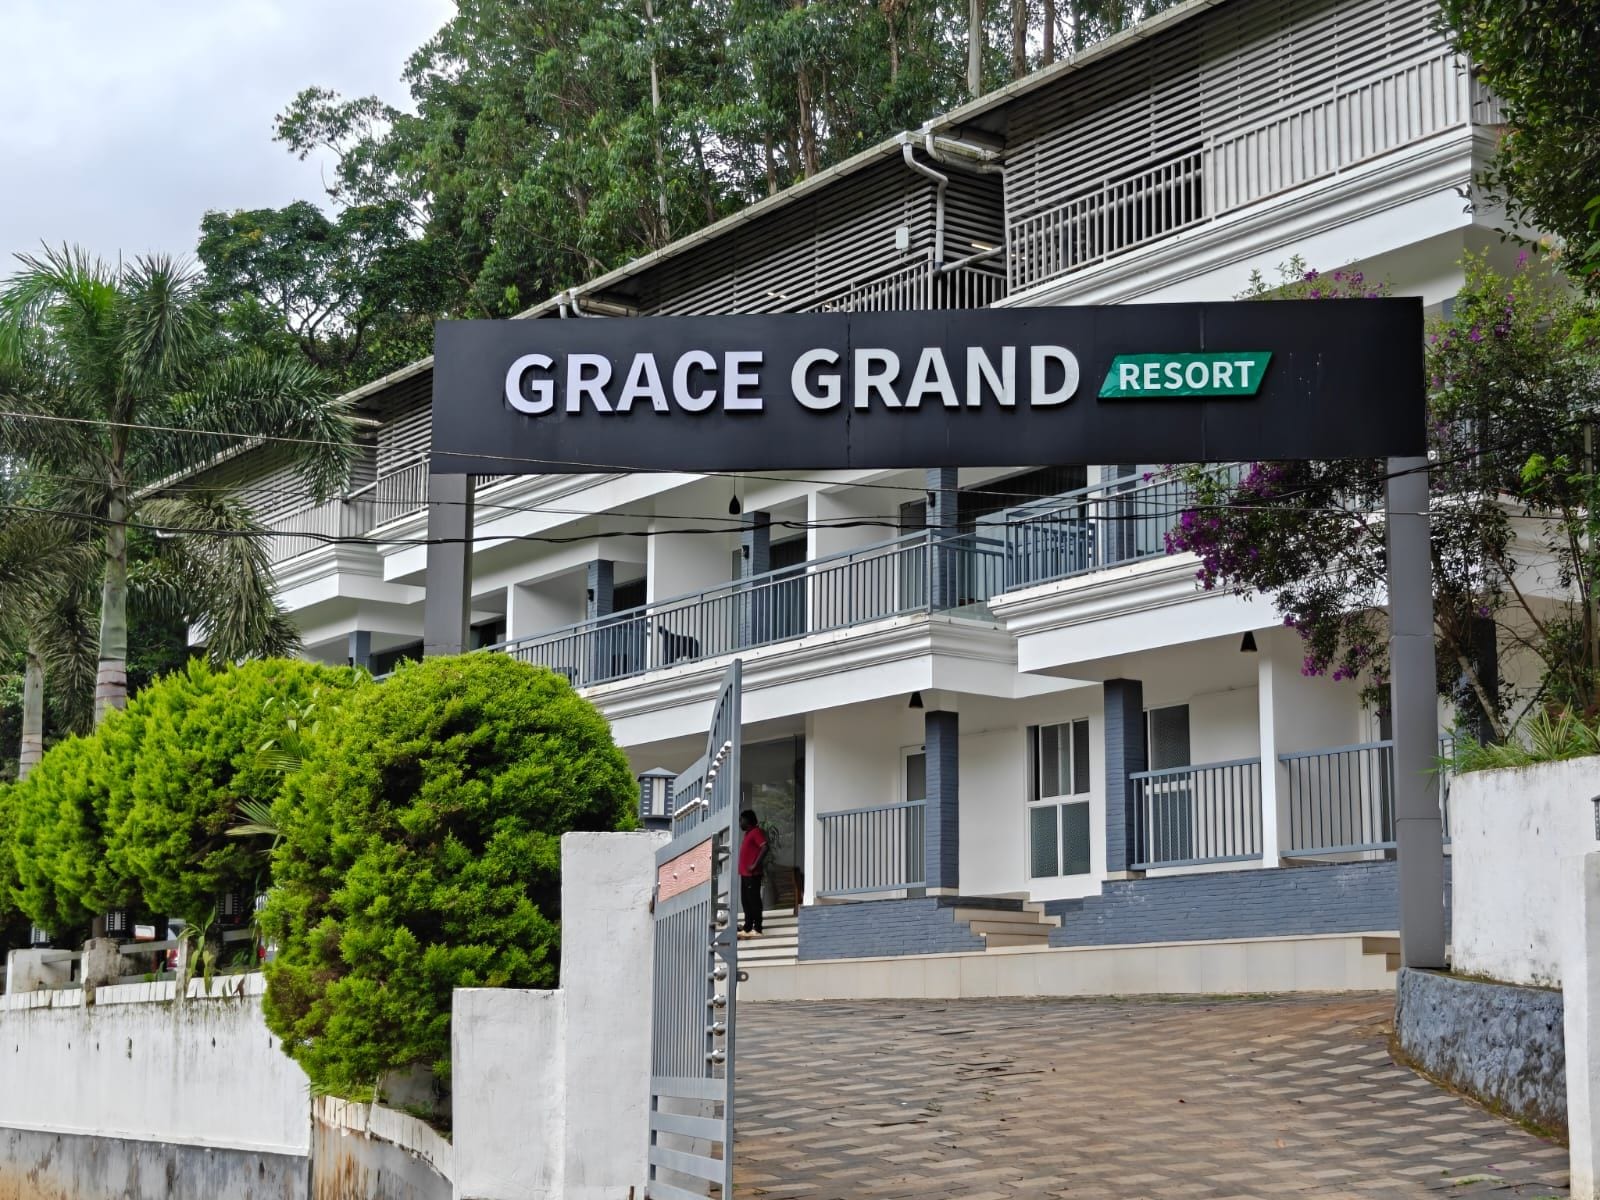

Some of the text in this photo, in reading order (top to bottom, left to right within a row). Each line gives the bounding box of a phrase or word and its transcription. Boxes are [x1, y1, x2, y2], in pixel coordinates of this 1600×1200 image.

[505, 345, 1255, 415] GRACE GRAND RESORT
